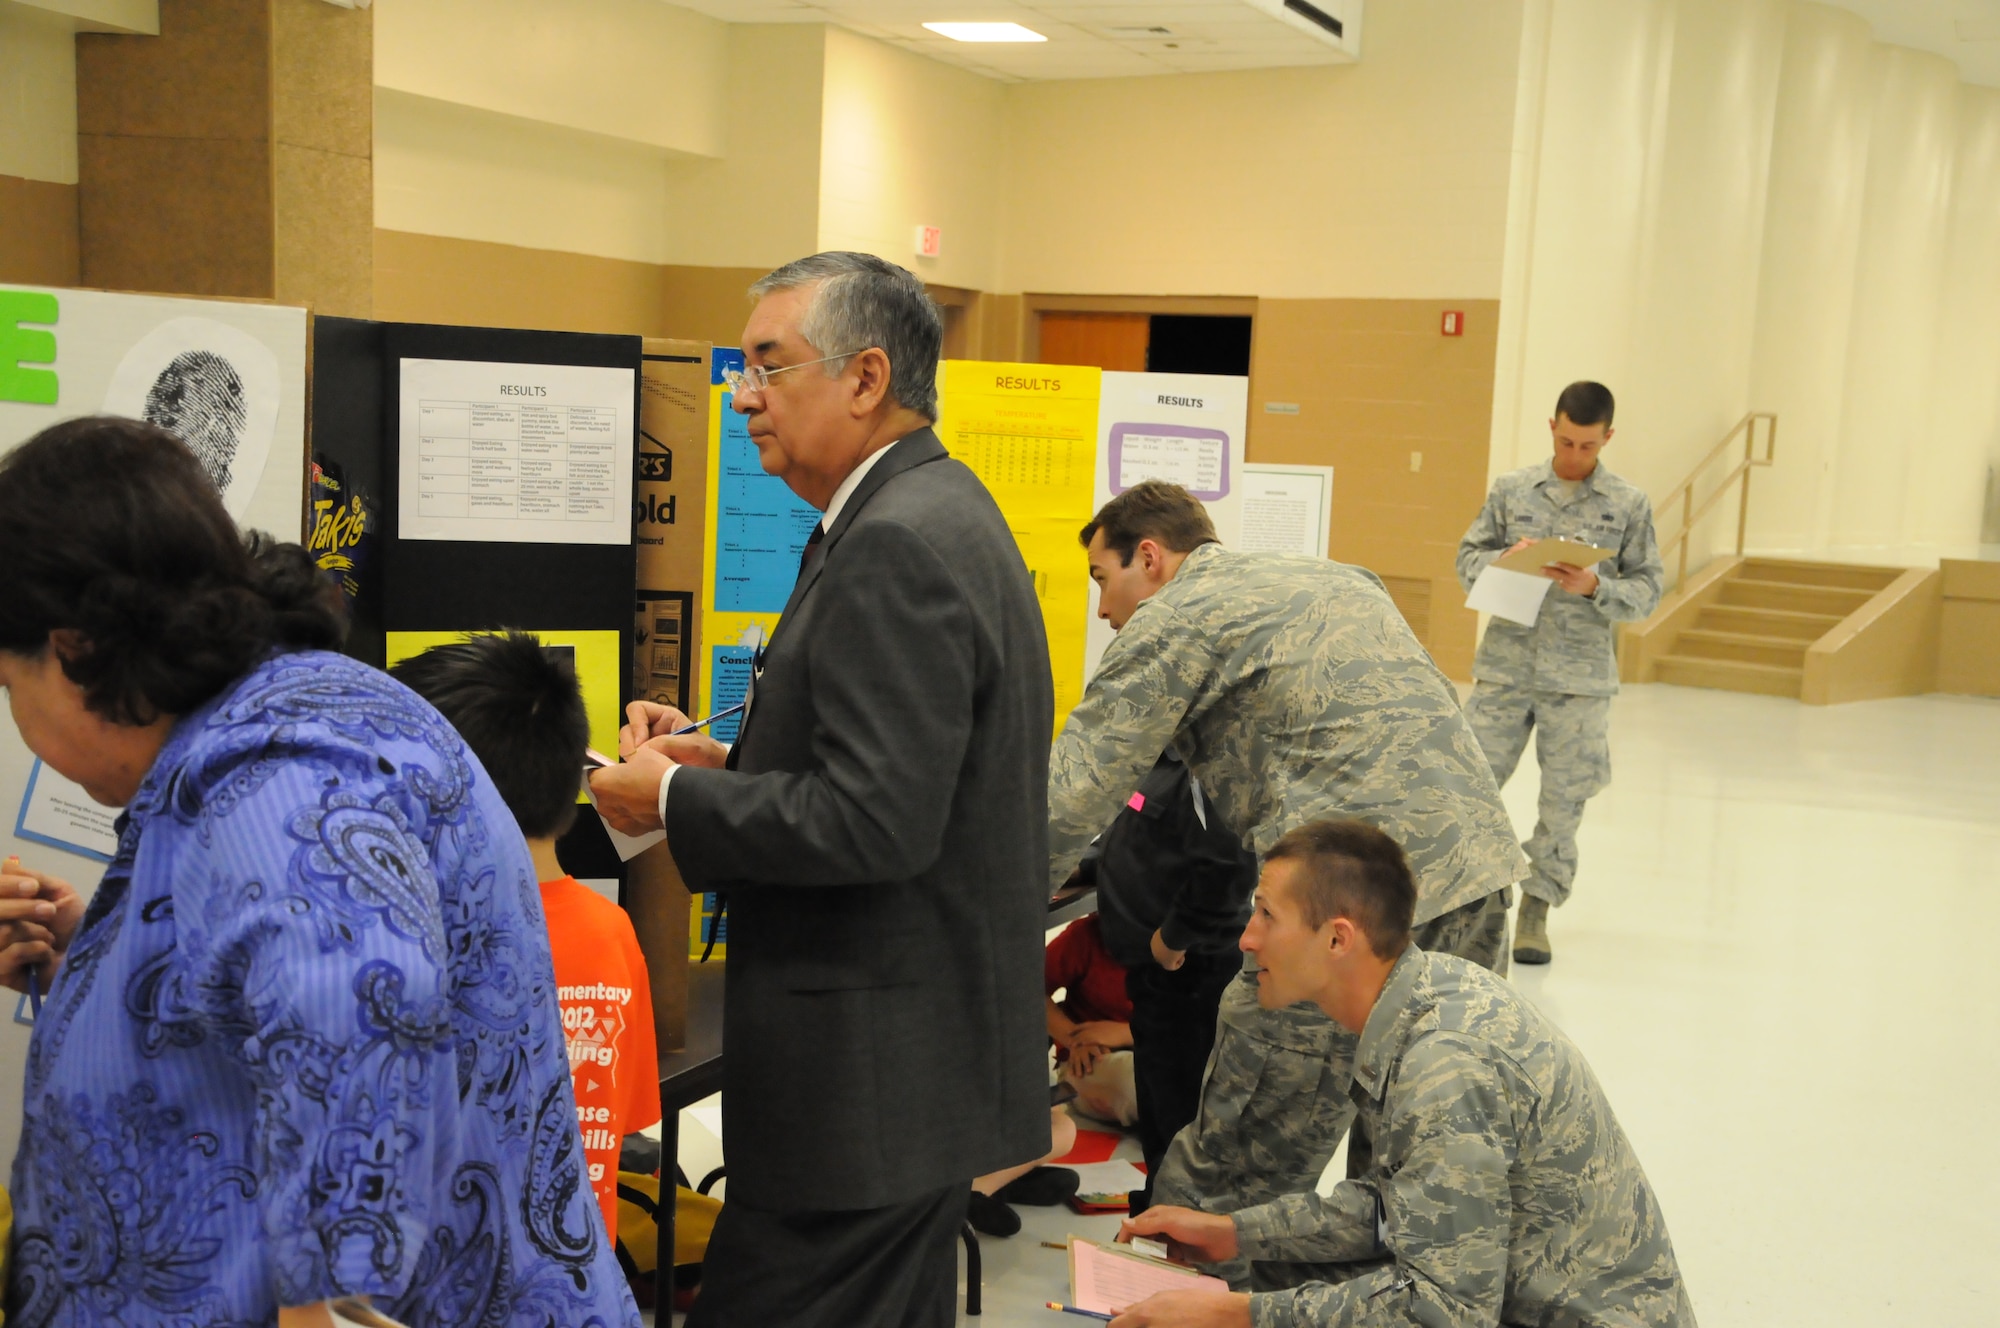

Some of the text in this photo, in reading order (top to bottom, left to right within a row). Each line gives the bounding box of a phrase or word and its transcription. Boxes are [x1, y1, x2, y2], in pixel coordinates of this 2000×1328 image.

[996, 376, 1061, 391] RESULTS
[500, 384, 547, 397] RESULTS
[1157, 395, 1203, 408] RESULTS
[995, 410, 1047, 419] TEMPERATURE
[308, 495, 366, 554] Takis
[64, 801, 81, 811] leaving
[69, 812, 89, 820] minutes
